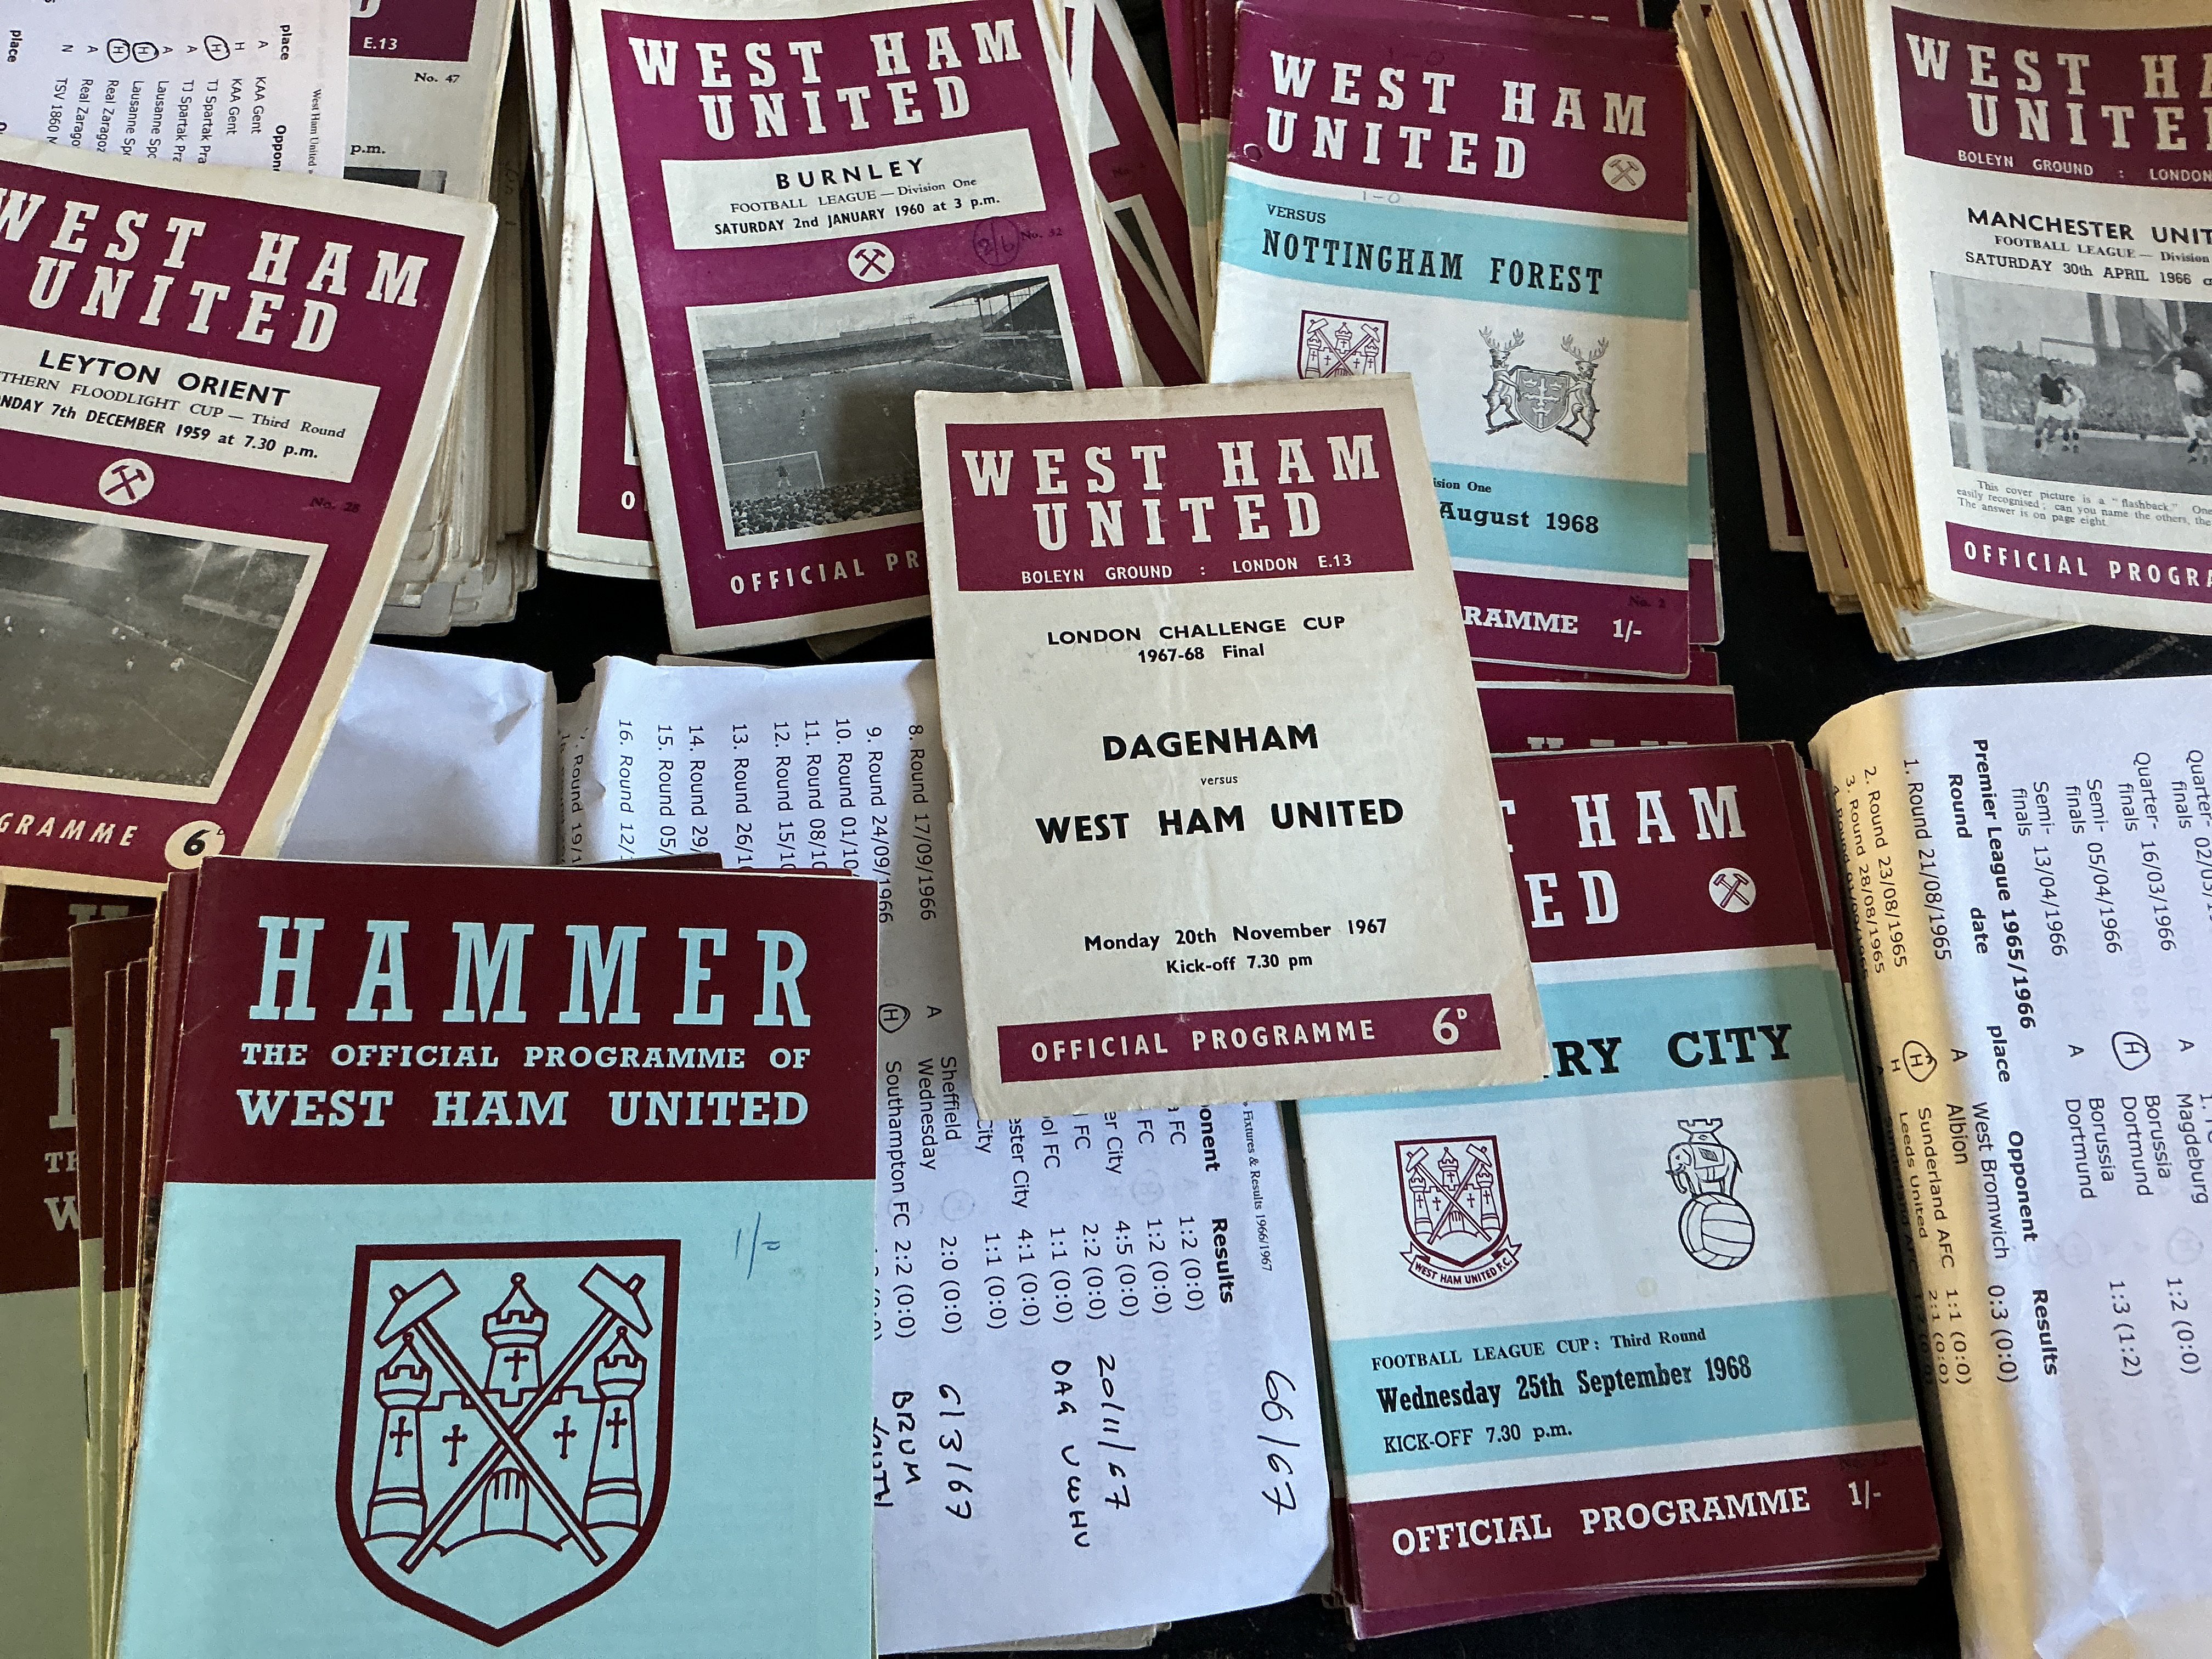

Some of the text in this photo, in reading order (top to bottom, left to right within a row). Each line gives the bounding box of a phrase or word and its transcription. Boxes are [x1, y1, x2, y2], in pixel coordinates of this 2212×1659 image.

[7, 30, 22, 63] place
[280, 25, 290, 60] place
[363, 37, 397, 51] E.13
[628, 18, 1022, 88] WEST HAM
[1905, 32, 2090, 97] WEST
[78, 80, 93, 103] Real
[415, 72, 460, 83] No. 47
[1269, 50, 1647, 138] WEST HAM
[48, 78, 68, 132] TSV 1860
[126, 81, 145, 134] Lausanne
[177, 97, 192, 142] Spartak
[251, 76, 267, 134] KAA Gent
[698, 75, 971, 142] UNITED
[1265, 106, 1527, 180] UNITED
[1958, 149, 2015, 168] BOLEYN
[731, 180, 945, 213] FOOTBALL LEAGUE Division
[776, 157, 926, 190] BURNLEY
[714, 201, 925, 236] SATURDAY 2nd JANUARY 1960
[1267, 203, 1327, 224] VERSUS
[1967, 207, 2134, 241] MANCHESTER
[0, 188, 429, 307] WEST HAM
[1262, 227, 1604, 296] NOTTINGHAM FOREST
[1966, 252, 2192, 285] SATURDAY 30th APRIL 1966
[29, 257, 337, 353] UNITED
[40, 349, 290, 407] LEYTON ORIENT
[51, 404, 276, 452] 7th DECEMBER 1959 7.30
[70, 383, 289, 430] FLOODLIGHT CUP Third
[962, 434, 1380, 498] WEST HAM
[1467, 481, 1492, 493] One
[1032, 492, 1322, 552] UNITED
[1440, 501, 1600, 534] August 1968
[1982, 502, 2015, 515] answer
[2052, 514, 2075, 524] page
[2040, 492, 2075, 502] picture
[730, 560, 865, 595] OFFICIAL
[1021, 556, 1298, 586] BOLEYN GROUND LONDON
[1046, 614, 1345, 647] LONDON CHALLENGE CUP
[1138, 642, 1265, 665] 1967-68 Final
[617, 719, 633, 746] 16.
[1102, 723, 1318, 763] DAGENHAM
[733, 758, 752, 815] Round
[1200, 773, 1239, 786] versus
[867, 751, 894, 924] Round 24/09/1966
[1035, 797, 1404, 845] WEST HAM UNITED
[1570, 785, 1747, 849] HAM
[914, 814, 936, 921] 17/09/1966
[2033, 781, 2068, 956] Semi- 13/04/1966
[2133, 751, 2176, 952] Quarter- 16/03/1966
[1918, 848, 1953, 961] 21/08/1965
[1973, 738, 2036, 1029] Premier League 1965/1966
[1084, 916, 1388, 954] Monday 20th November 1967
[1878, 856, 1908, 968] 23/08/1965
[1970, 907, 1989, 955] date
[248, 915, 811, 1028] HAMMER
[1166, 953, 1235, 975] Kick-off
[241, 1042, 746, 1070] THE OFFICIAL PROGRAMME
[1030, 1018, 1376, 1063] OFFICIAL PROGRAMME
[1667, 1023, 1792, 1069] CITY
[237, 1088, 809, 1127] WEST HAM UNITED
[917, 1058, 938, 1171] Wednesday
[1946, 1103, 1968, 1164] Albion
[940, 1056, 962, 1272] Sheffield 2:0
[1899, 1111, 1915, 1167] Leeds
[2065, 1098, 2095, 1199] Dortmund
[2089, 1098, 2114, 1182] Borussia
[2176, 1093, 2208, 1205] Magdeburg
[885, 1060, 916, 1338] Southampton 2:2 (0:0)
[1012, 1170, 1030, 1208] City
[1242, 1110, 1272, 1273] Fixtures 1966/1967
[1917, 1107, 1955, 1269] Sunderland AFC
[1971, 1101, 2008, 1321] West Bromwich 0:3
[1987, 1025, 2058, 1375] place Opponent Results
[1116, 1220, 1133, 1255] 4:5
[1211, 1218, 1234, 1305] Results
[1415, 1262, 1437, 1280] WEST
[1440, 1274, 1462, 1285] HAM
[1465, 1267, 1498, 1284] UNITED
[1371, 1348, 1463, 1372] FOOTBALL
[1472, 1341, 1545, 1362] LEAGUE
[1376, 1363, 1693, 1415] Wednesday 25th September
[1257, 1370, 1300, 1516] 66/67
[1384, 1427, 1474, 1454] KICK-OFF
[1392, 1486, 1812, 1558] OFFICIAL PROGRAMME
